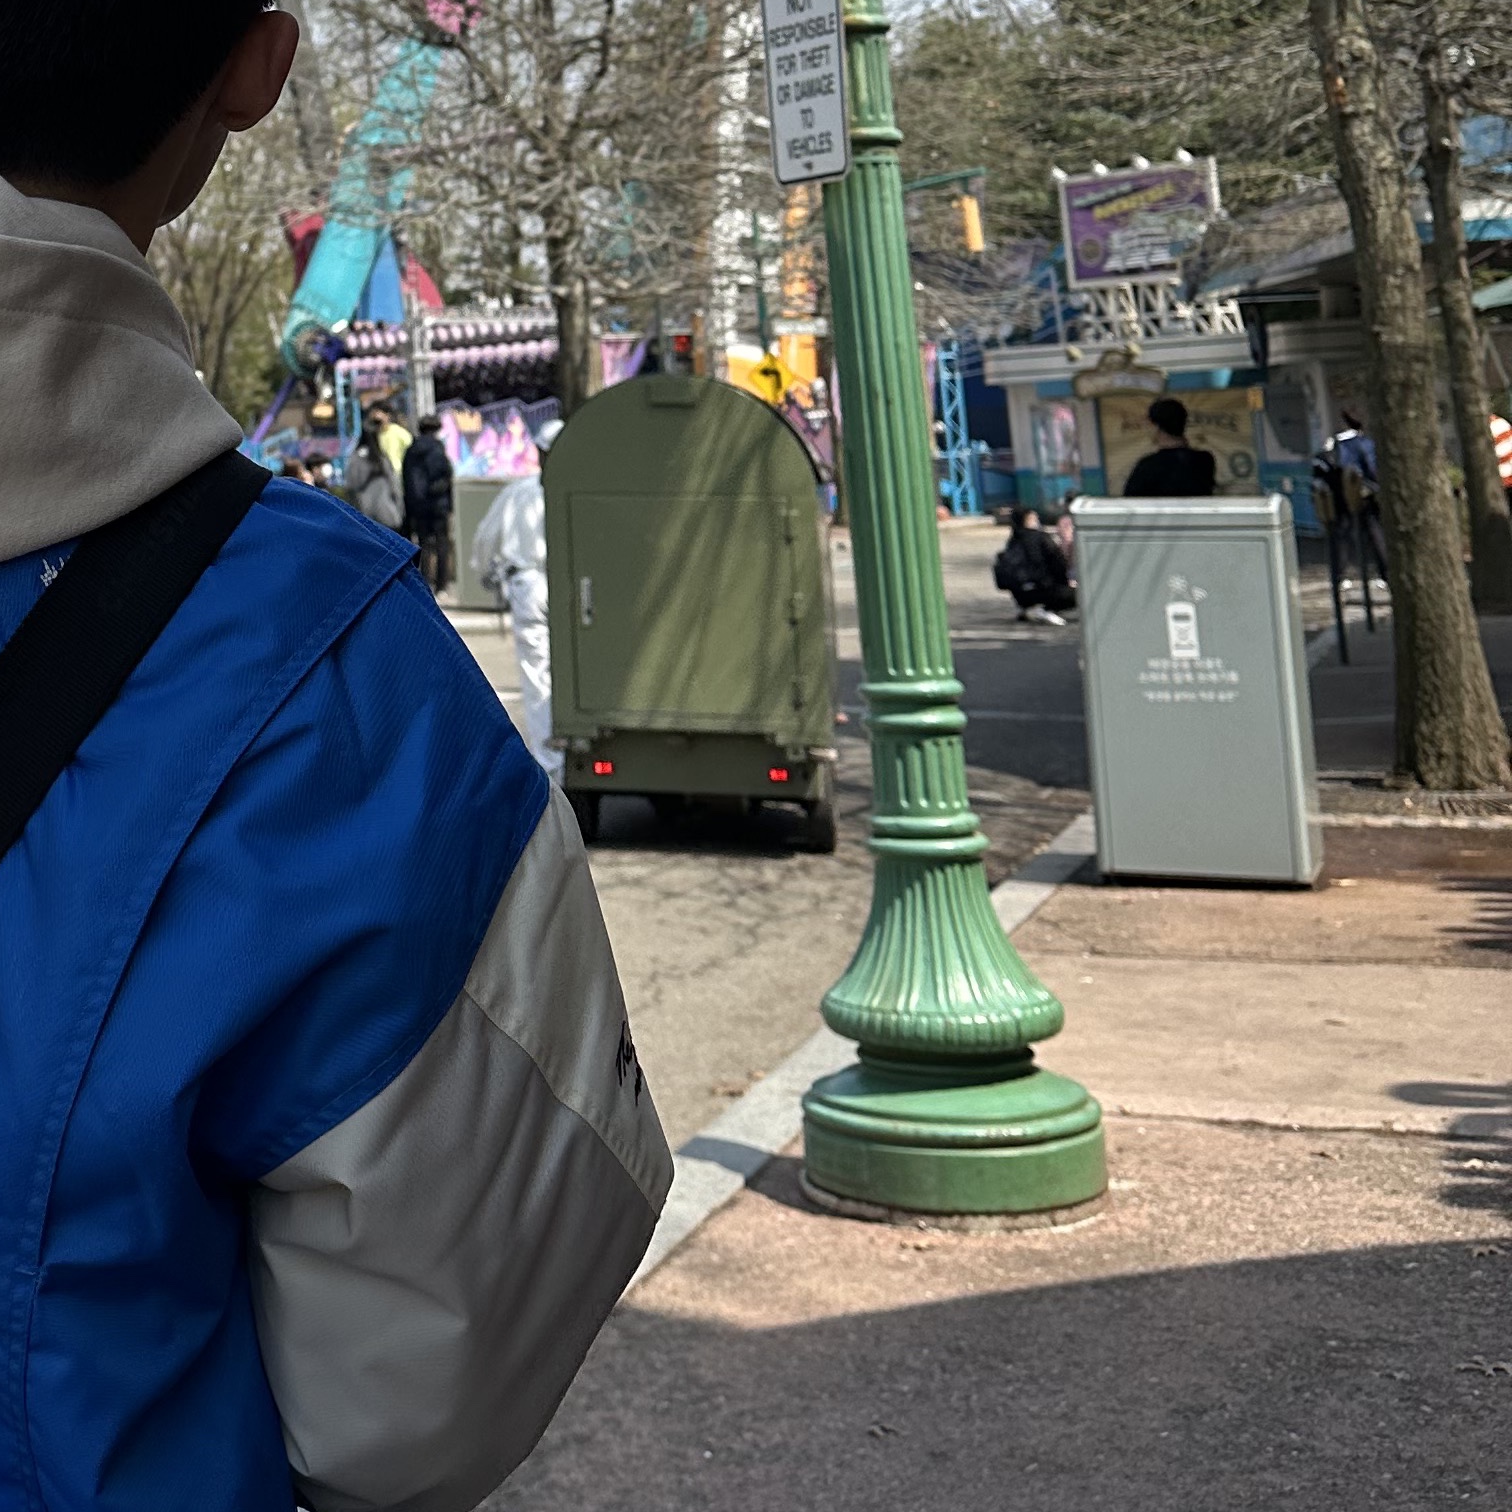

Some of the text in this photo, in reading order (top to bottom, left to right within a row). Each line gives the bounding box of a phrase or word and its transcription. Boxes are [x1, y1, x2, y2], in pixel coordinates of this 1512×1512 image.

[769, 13, 835, 48] RESPONSIBLE
[776, 45, 830, 77] FOR THEFT
[776, 73, 834, 105] OR DAMAGE
[800, 108, 814, 129] TO
[786, 132, 832, 159] VEHICLES
